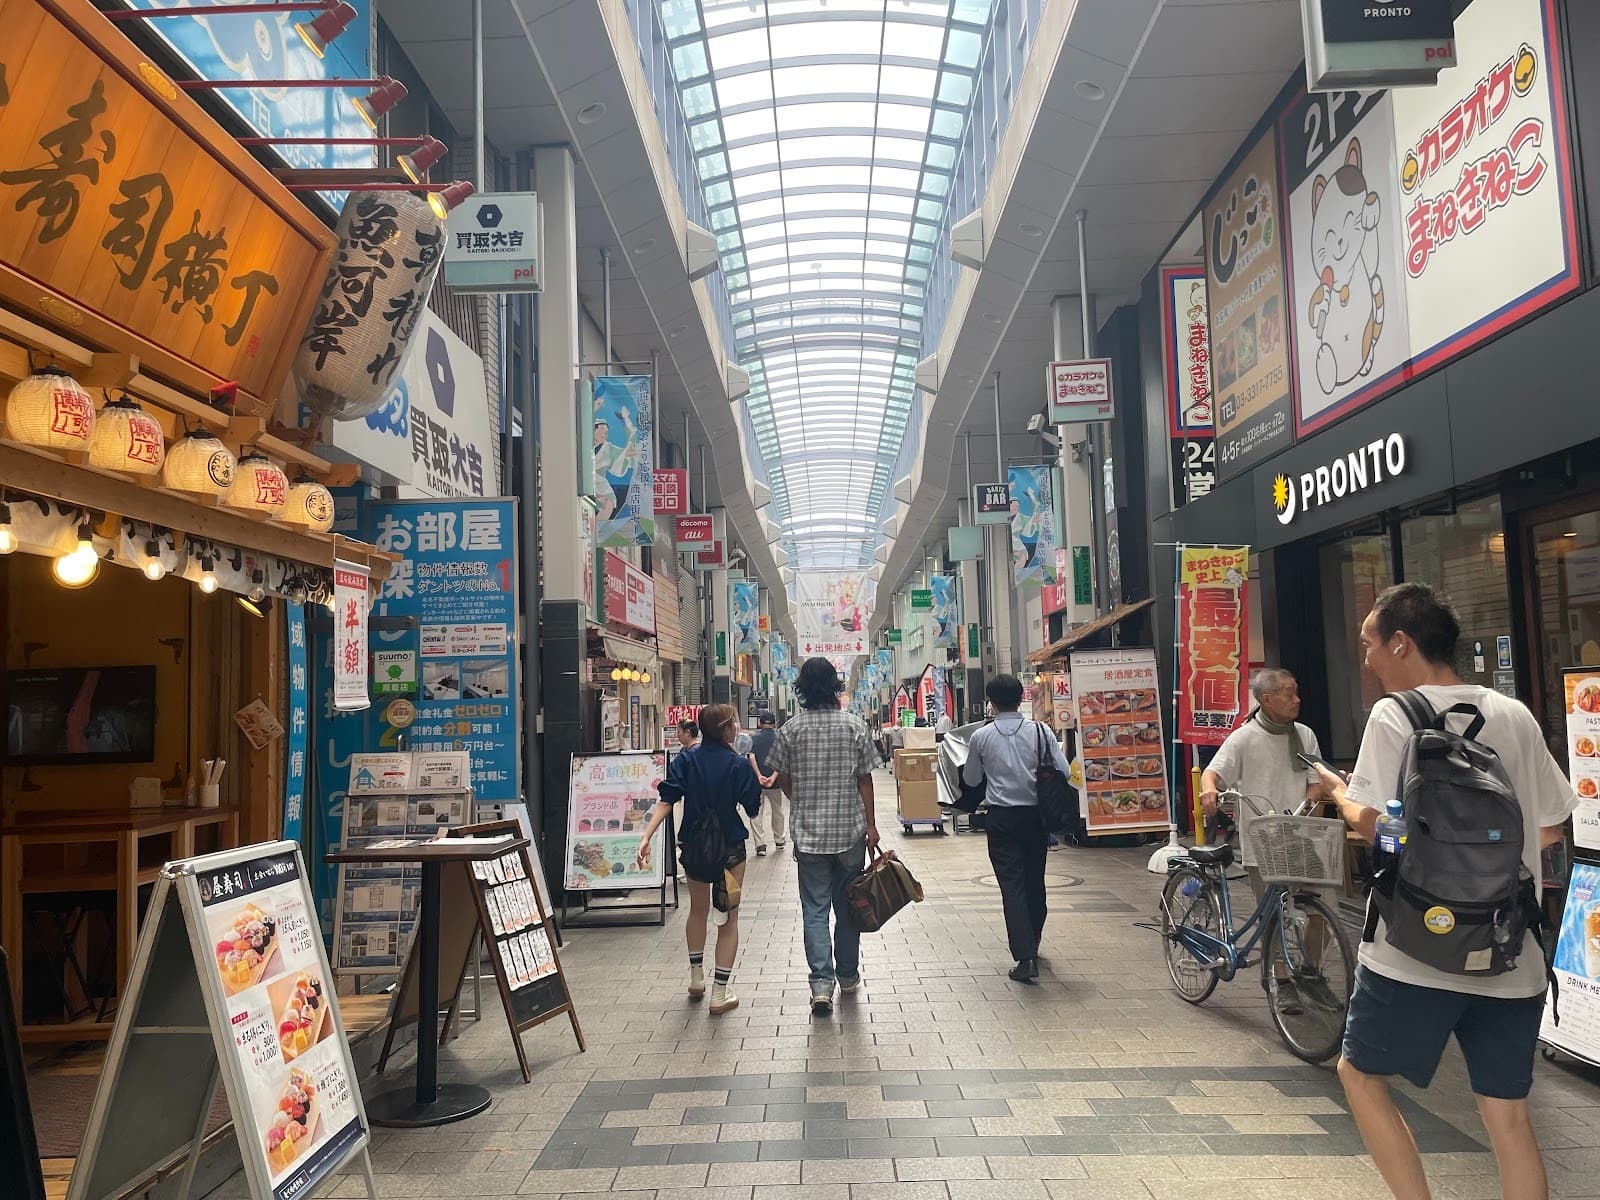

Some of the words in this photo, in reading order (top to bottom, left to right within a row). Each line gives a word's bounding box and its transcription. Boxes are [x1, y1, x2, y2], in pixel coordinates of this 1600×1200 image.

[1364, 7, 1411, 18] PRONTO
[1424, 41, 1453, 62] pal
[1416, 61, 1513, 180] カラオケ
[0, 62, 279, 347] 寿司横丁
[1408, 120, 1547, 275] まねきねこ
[455, 230, 524, 249] 買取大吉
[513, 264, 534, 280] pal
[1063, 371, 1097, 381] カラオケ
[1188, 322, 1212, 422] まねきねこ
[1058, 383, 1105, 398] まねきねこ
[1220, 402, 1236, 418] TEL
[410, 404, 484, 497] 買取大吉
[653, 473, 678, 481] スマホ
[1300, 432, 1405, 512] PRONTO
[653, 482, 678, 495] 相談
[985, 493, 1007, 505] BAR
[375, 509, 502, 552] お部屋
[680, 519, 708, 527] docomo
[684, 529, 704, 540] au
[417, 561, 489, 578] 物件情報数
[1185, 552, 1245, 572] まねきねこ
[1195, 570, 1222, 584] 史上
[344, 597, 360, 675] 半額
[815, 643, 852, 654] 出発地点
[1189, 584, 1241, 714] 最安値
[378, 653, 409, 661] suumo
[1103, 667, 1153, 680] 居酒屋定食
[1055, 681, 1069, 696] 氷
[414, 704, 509, 719] 金礼金ゼロゼロ！
[589, 763, 648, 781] 高額買取
[583, 801, 619, 811] ブランド品
[1580, 817, 1600, 826] SALAD
[1567, 976, 1588, 990] DRINK
